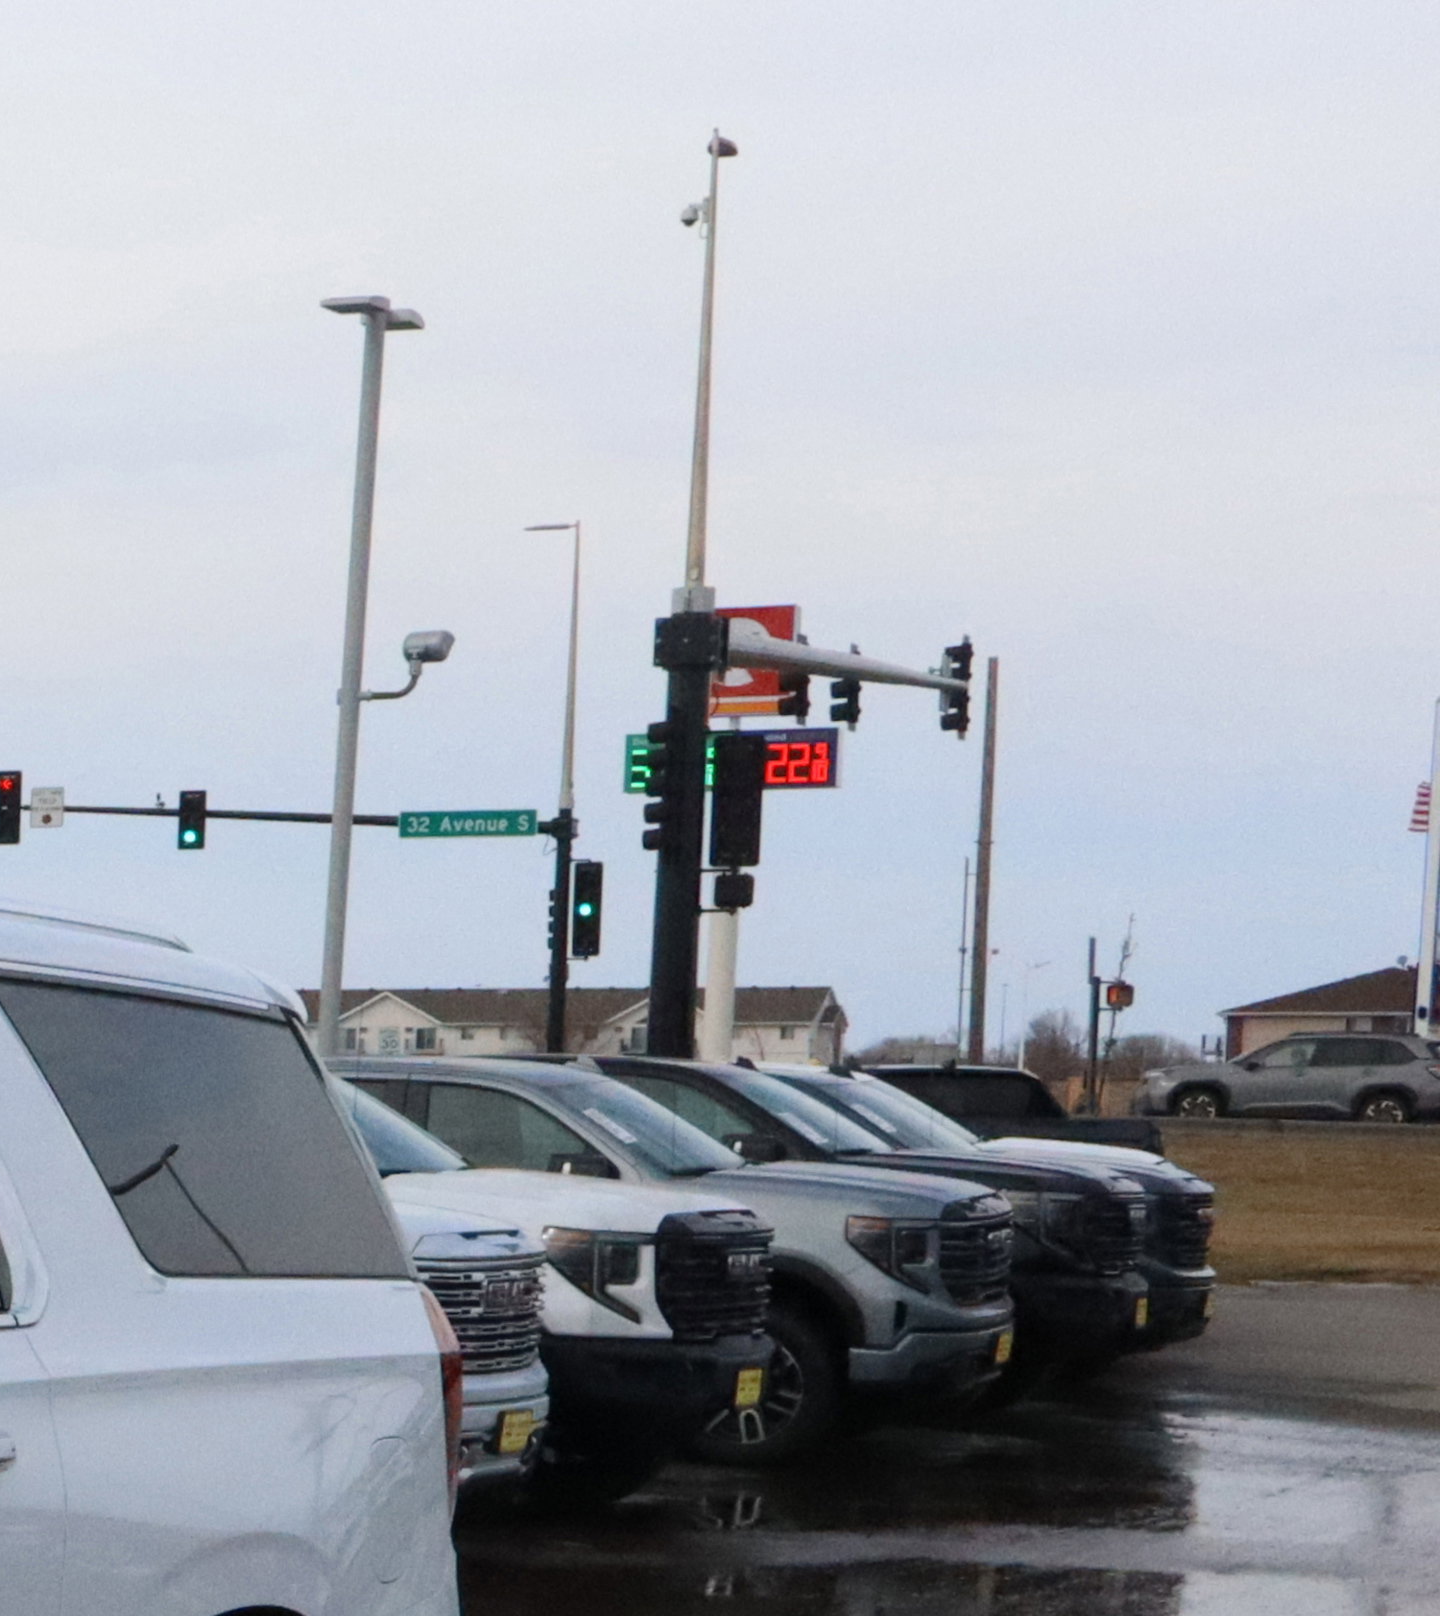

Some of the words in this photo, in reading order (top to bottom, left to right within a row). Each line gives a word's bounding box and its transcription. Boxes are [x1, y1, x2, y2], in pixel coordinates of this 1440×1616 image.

[407, 816, 430, 833] 32
[440, 816, 509, 832] Avenue
[517, 815, 530, 832] S
